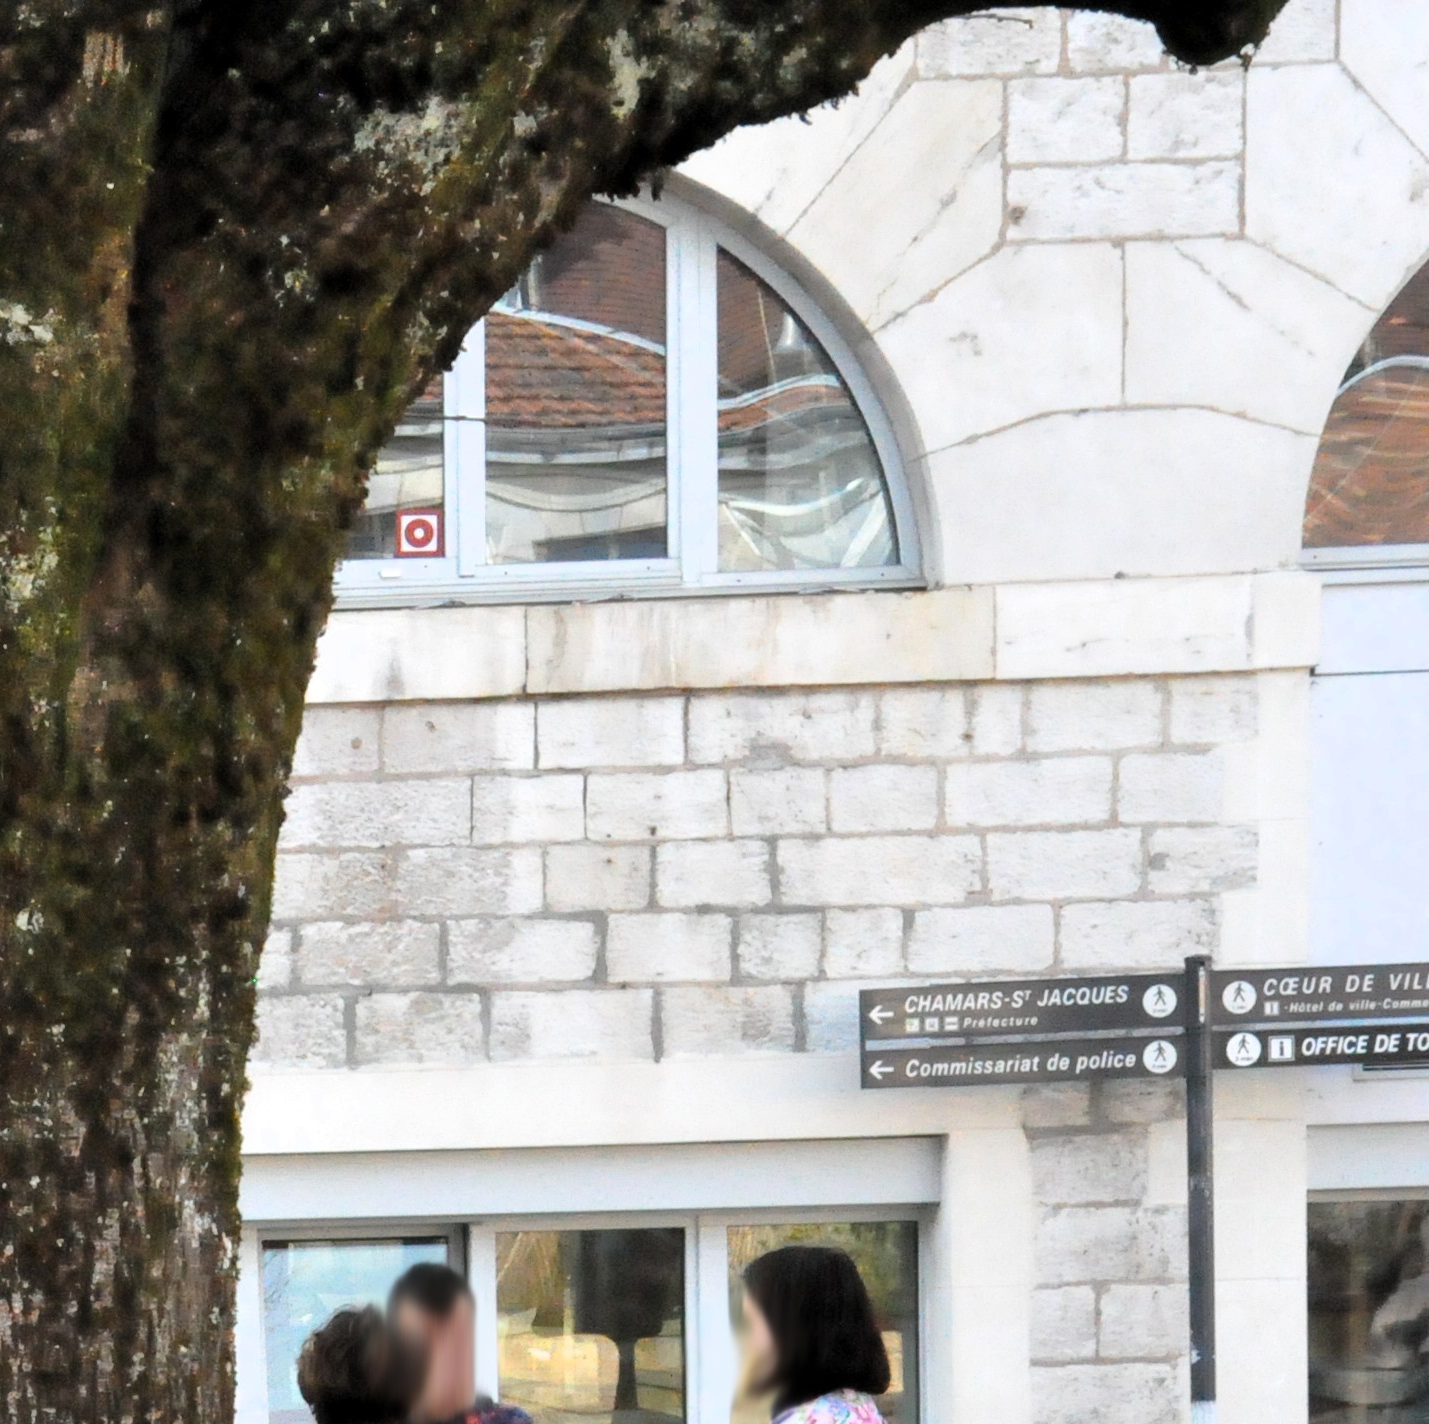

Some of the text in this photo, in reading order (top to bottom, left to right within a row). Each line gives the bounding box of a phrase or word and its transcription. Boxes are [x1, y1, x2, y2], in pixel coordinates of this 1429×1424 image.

[1263, 976, 1333, 996] CŒUR
[1345, 974, 1375, 993] DE
[1037, 985, 1129, 1008] JACQUES
[1328, 1001, 1344, 1012] de
[963, 1016, 1038, 1028] Préfecture
[1301, 1035, 1369, 1056] OFFICE
[1373, 1033, 1401, 1054] DE
[905, 1050, 1137, 1078] Commissariat de police
